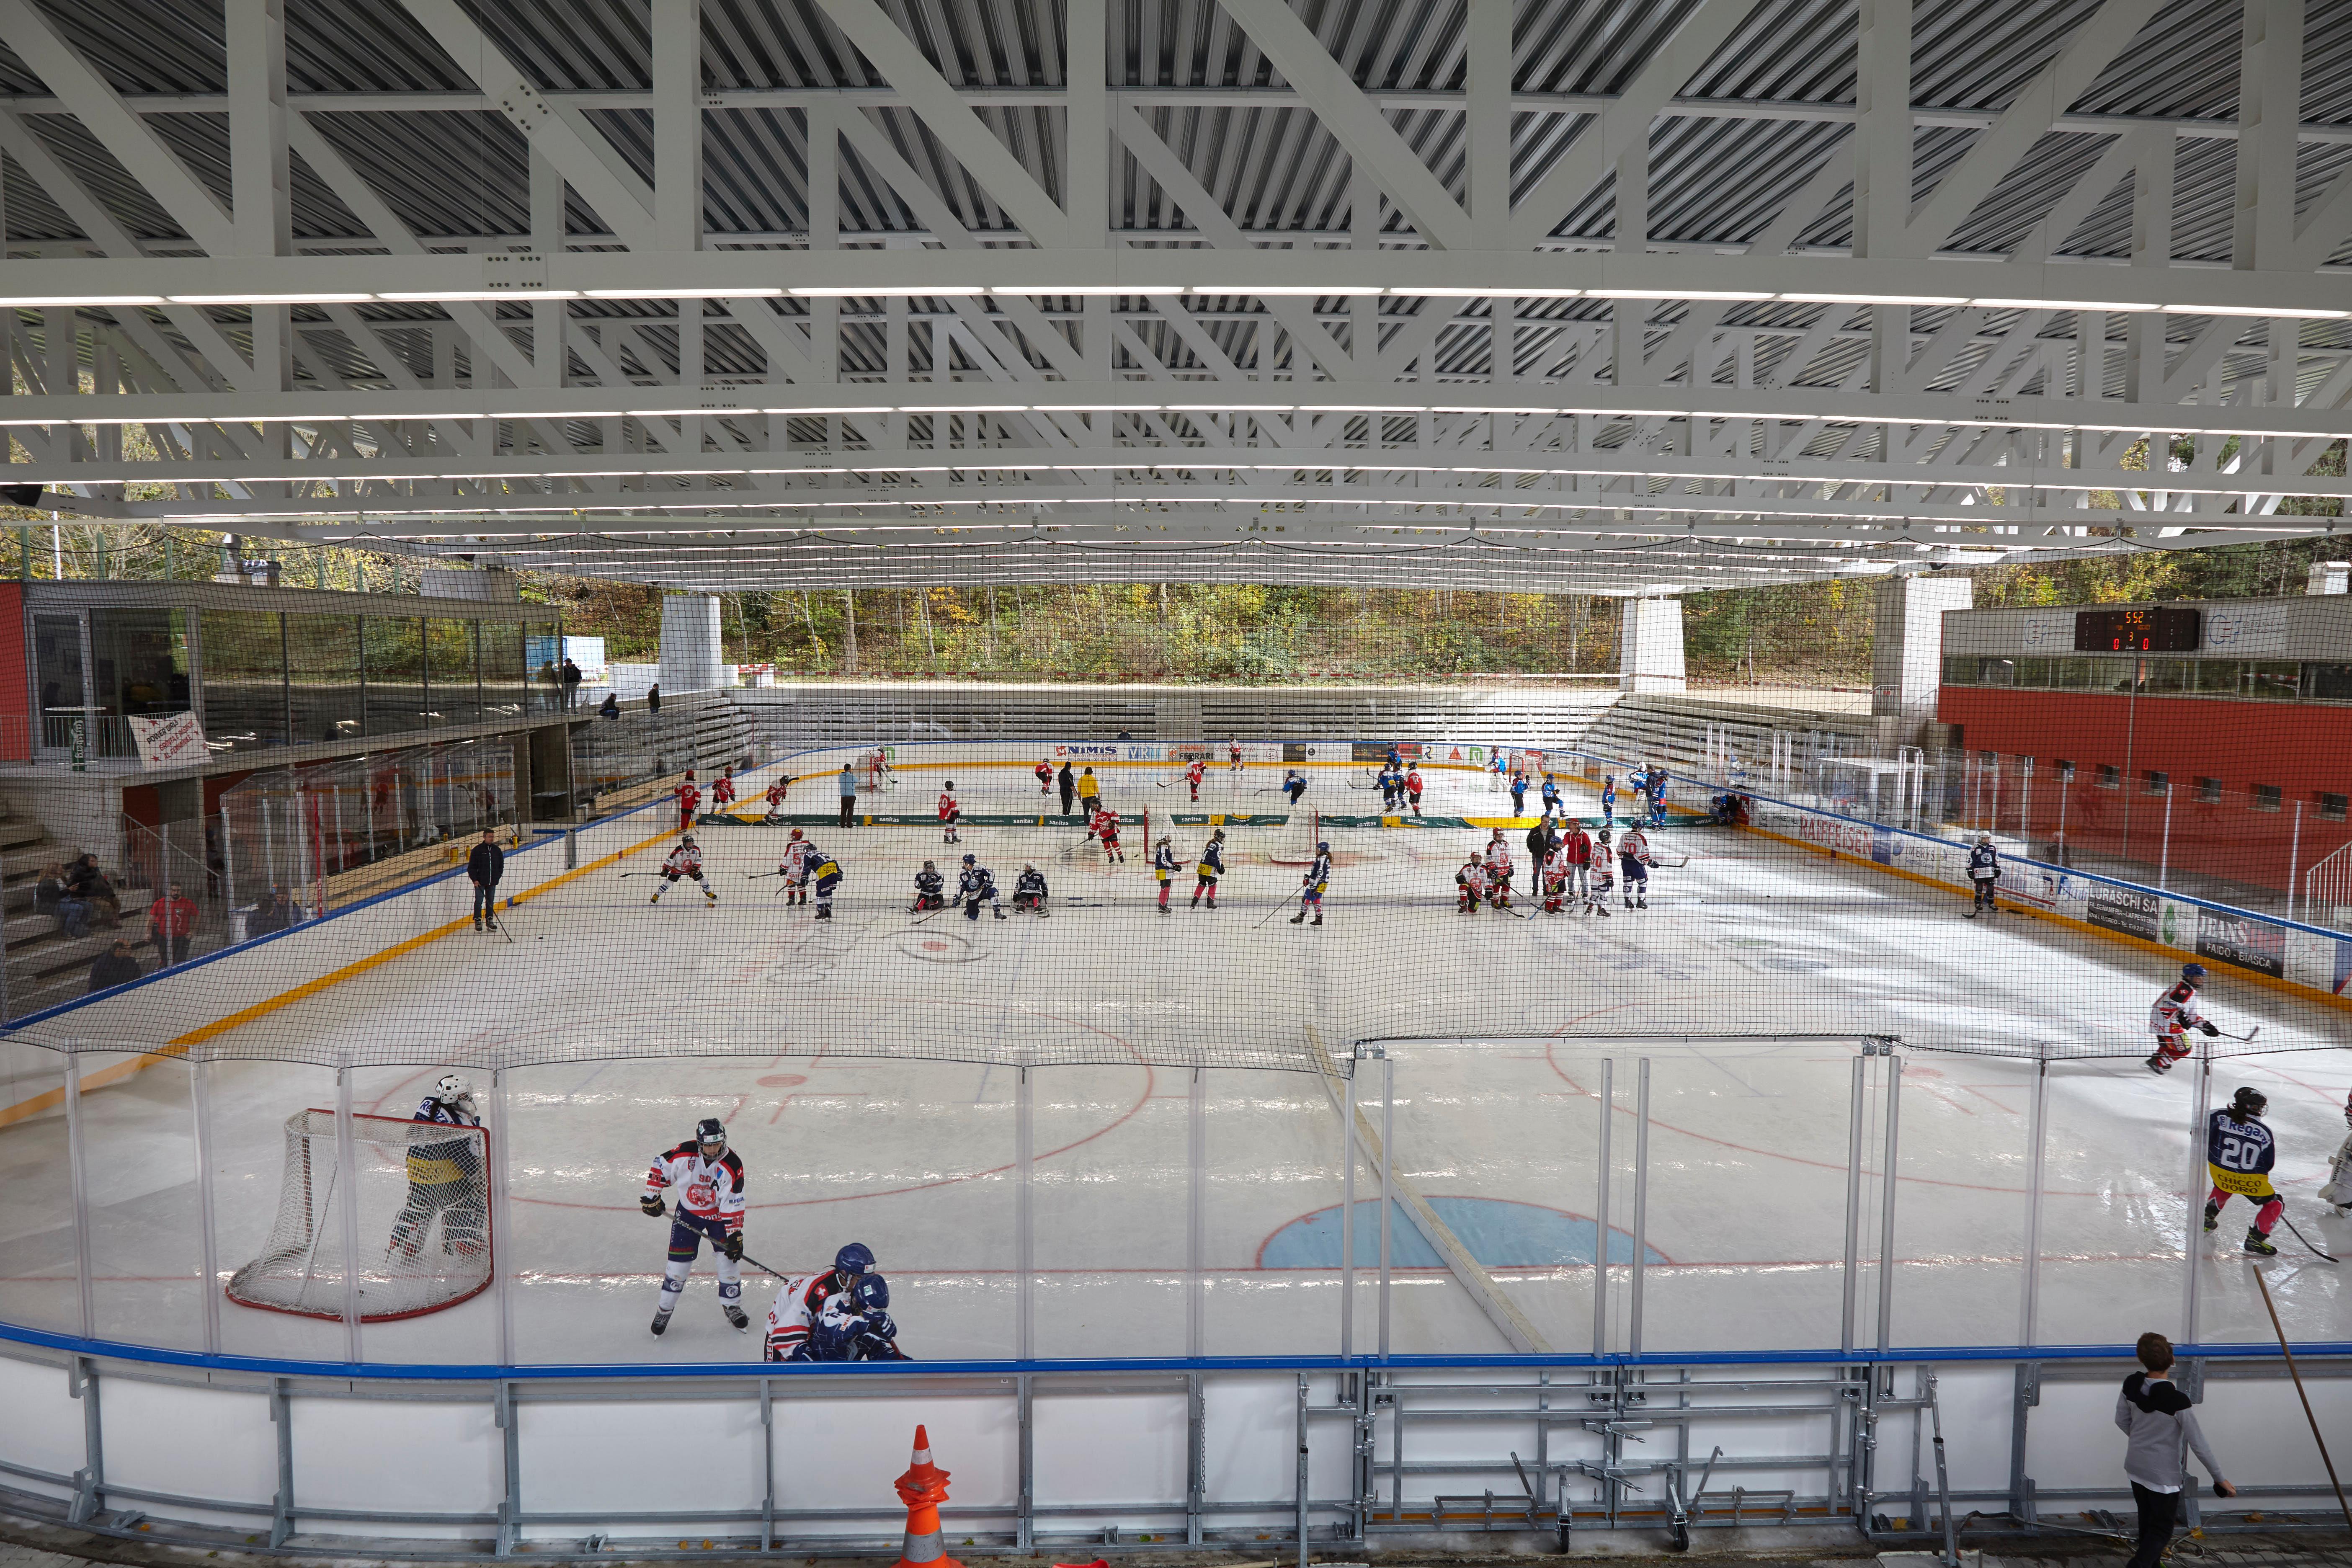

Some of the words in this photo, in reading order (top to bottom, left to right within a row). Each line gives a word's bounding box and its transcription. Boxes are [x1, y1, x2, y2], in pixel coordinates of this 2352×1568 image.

[2129, 631, 2133, 641] 3
[2113, 638, 2119, 650] 0
[2142, 638, 2149, 650] 0
[147, 728, 167, 745] POWER
[1193, 766, 1202, 775] 14
[684, 789, 694, 799] 9
[939, 797, 948, 809] 10
[1800, 815, 1873, 856] RAIFFEISEN
[1624, 842, 1636, 854] 70
[1906, 843, 1935, 861] IMERYS
[2089, 884, 2140, 910] LURASCHI
[2142, 898, 2158, 915] SA
[2206, 942, 2231, 957] FAIDO
[2239, 951, 2272, 969] BIASCA
[2220, 1137, 2261, 1170] 20
[710, 1179, 720, 1191] A
[2218, 1174, 2262, 1187] CHICCO
